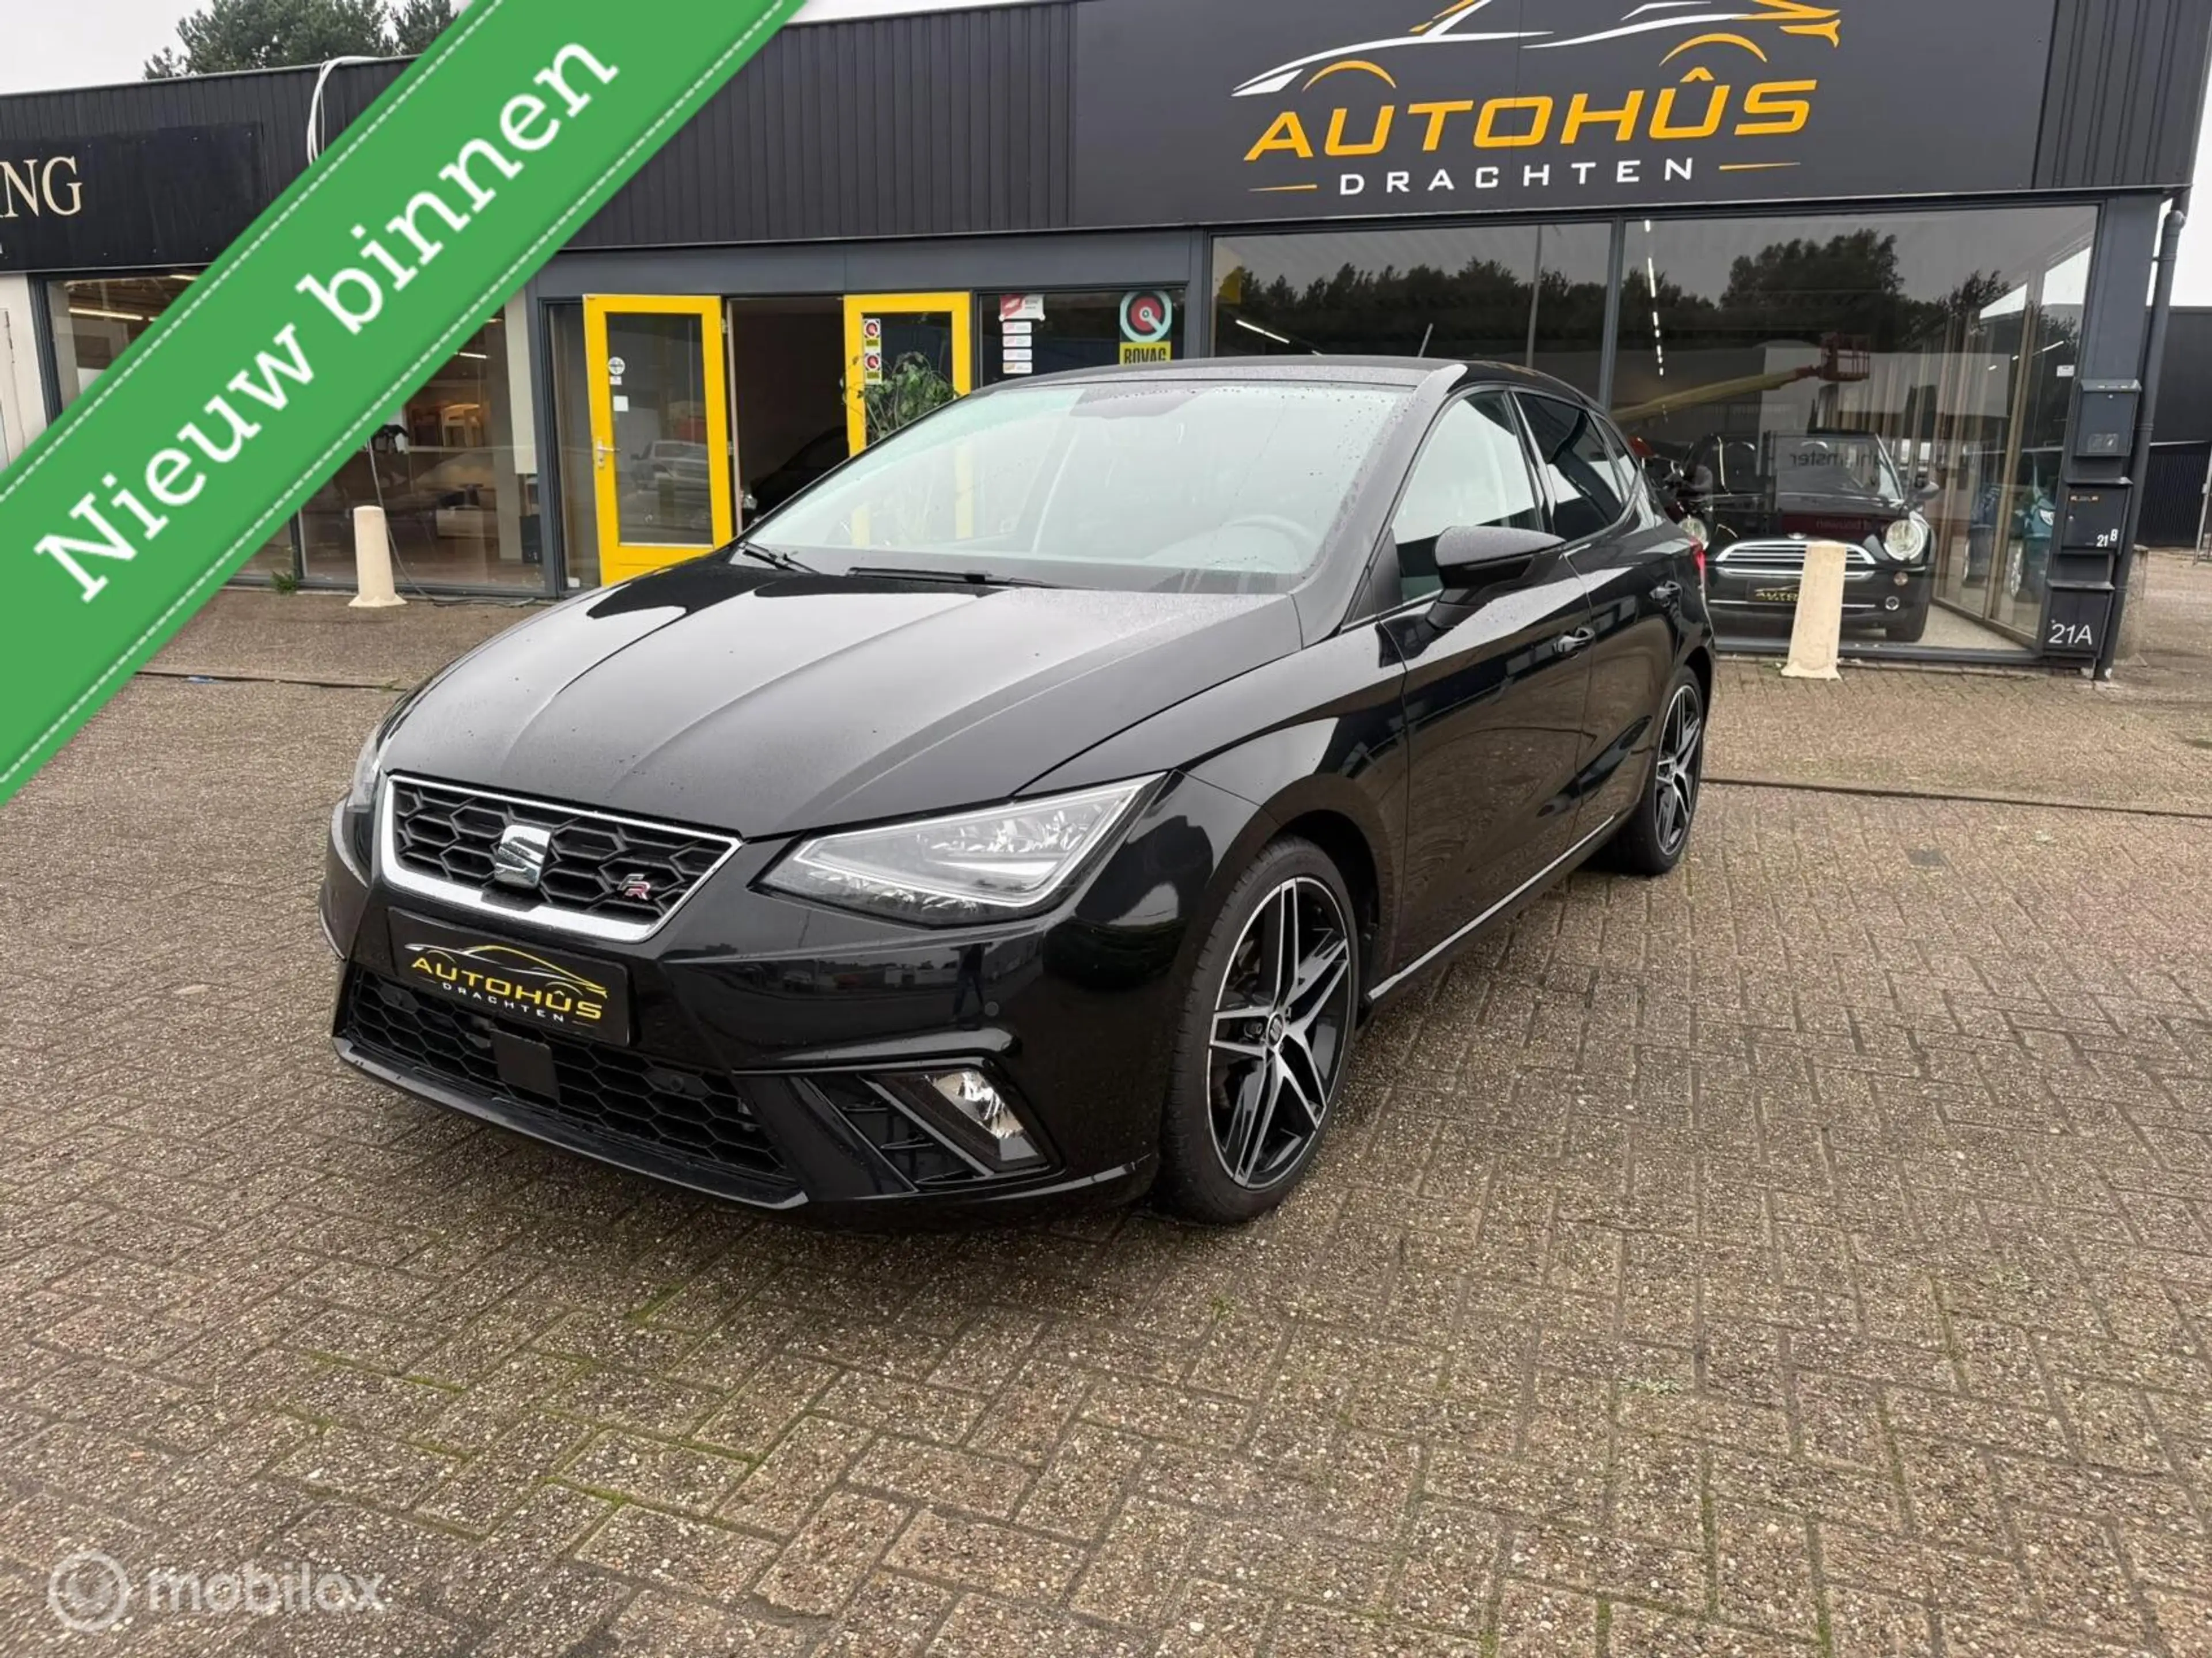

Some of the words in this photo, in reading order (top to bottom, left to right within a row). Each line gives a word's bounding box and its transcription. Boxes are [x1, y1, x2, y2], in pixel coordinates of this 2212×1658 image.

[1243, 67, 1817, 161] AUTOHÛS
[0, 155, 83, 218] NG
[1340, 157, 1692, 195] DRACHTEN
[2048, 623, 2093, 646] 21A
[411, 957, 603, 1020] AUTOHÛS
[442, 982, 565, 1022] DRACHTEN
